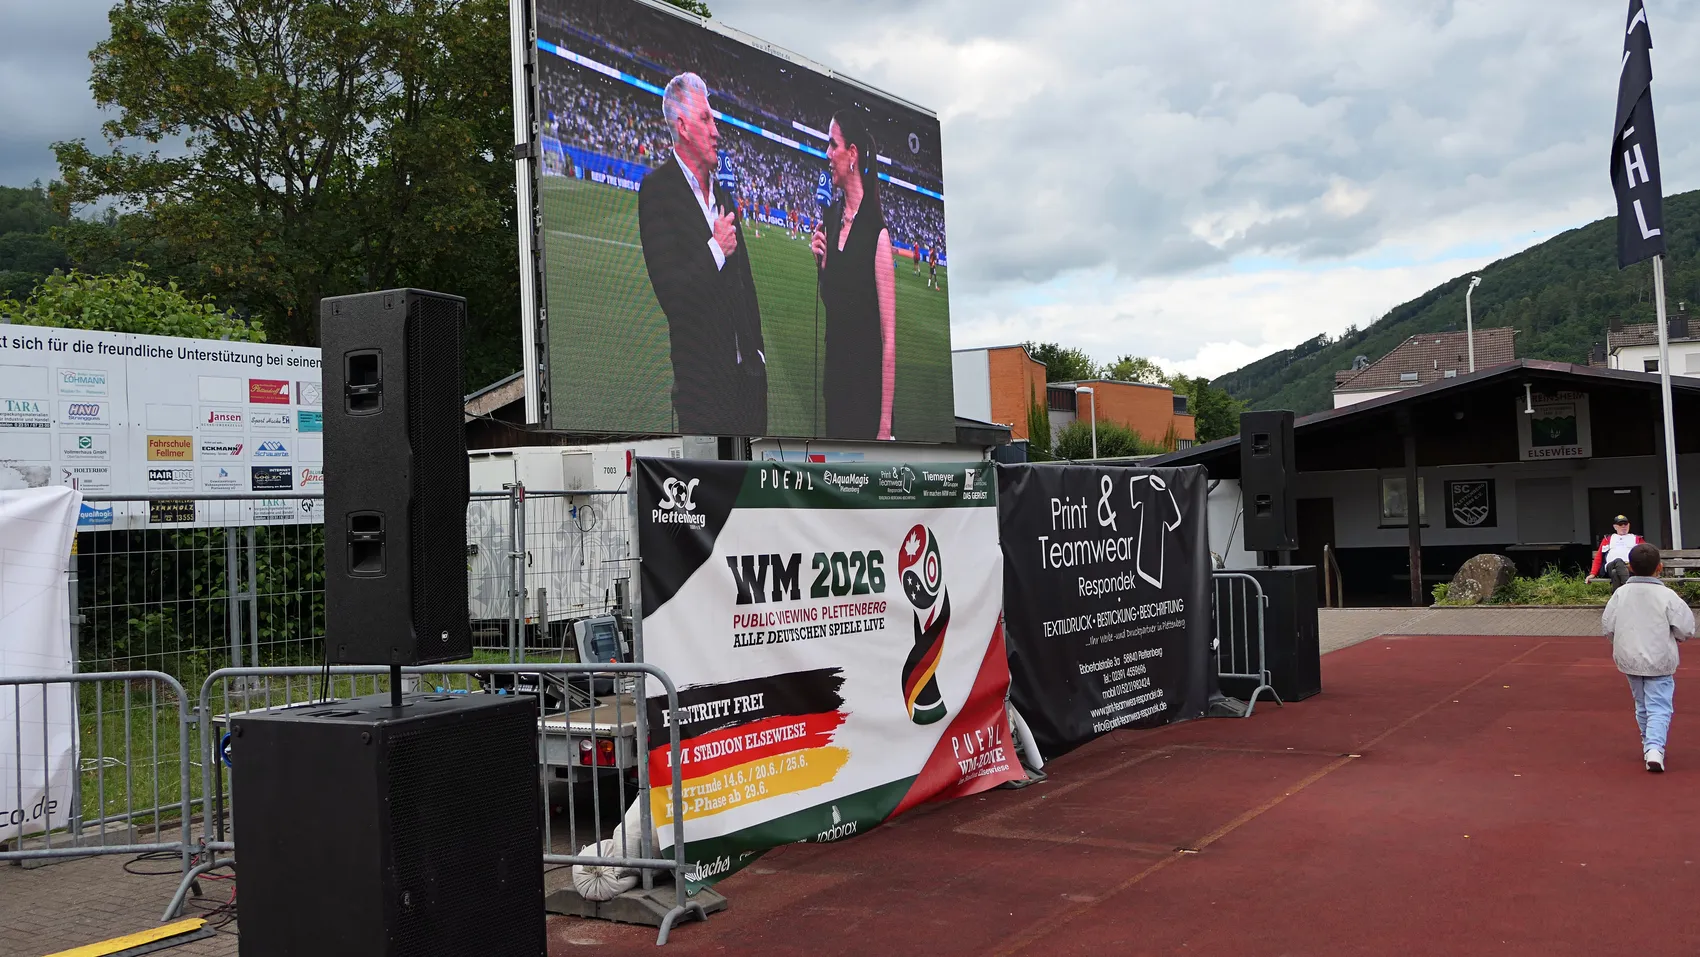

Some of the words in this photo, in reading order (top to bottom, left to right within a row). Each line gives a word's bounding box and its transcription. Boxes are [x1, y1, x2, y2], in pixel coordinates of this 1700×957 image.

[12, 336, 43, 351] sich
[48, 338, 68, 352] für
[73, 340, 94, 354] die
[98, 341, 173, 359] freundliche
[178, 347, 263, 367] Unterstützung
[267, 354, 284, 366] bei
[287, 356, 323, 369] seinen
[64, 375, 105, 385] LOHMANN
[5, 399, 40, 413] TARA
[68, 403, 100, 416] HAVO
[208, 411, 241, 423] Jansen
[149, 439, 191, 448] Fahrschule
[156, 449, 185, 457] Fellmer
[1528, 447, 1583, 458] ELSEWIESE
[149, 471, 172, 479] HAIR
[174, 471, 192, 479] LINE
[603, 466, 617, 475] 7003
[880, 470, 892, 479] Print
[892, 466, 899, 480] &
[922, 471, 955, 482] Tiemeyer
[760, 468, 814, 491] PUEHL
[832, 472, 869, 488] AquaMagis
[879, 478, 903, 487] Teamwear
[962, 491, 971, 500] DAS
[971, 489, 988, 500] GERÜST
[1453, 484, 1470, 494] SC
[1454, 483, 1485, 507] PLETTENBERG
[1051, 496, 1088, 531] Print
[1097, 474, 1118, 532] &
[80, 510, 112, 519] quaMagis
[652, 509, 706, 528] Plettenberg
[1038, 535, 1134, 569] Teamwear
[725, 553, 802, 606] WM
[810, 549, 886, 599] 2026
[1078, 570, 1136, 599] Respondek
[733, 611, 776, 629] PUBLIC
[776, 607, 818, 626] VIEWING
[821, 601, 887, 620] PLETTENBERG
[1043, 614, 1093, 638] TEXTILDRUCK
[1096, 606, 1137, 628] BESTICKUNG
[1139, 598, 1184, 620] BESCHRIFTUNG
[733, 632, 765, 649] ALLE
[766, 624, 827, 644] DEUTSCHEN
[829, 619, 862, 637] SPIELE
[863, 617, 885, 631] LIVE
[1123, 652, 1138, 665] 58840
[1137, 647, 1163, 660] Plettenberg
[1112, 669, 1125, 682] 02391
[1102, 688, 1116, 700] mobil
[733, 692, 765, 715] FREI
[693, 736, 743, 763] STADION
[745, 722, 807, 751] ELSEWIESE
[951, 724, 1002, 759] PUEHL
[958, 747, 1006, 775] WM-ZONE
[723, 771, 748, 787] 14.6.
[755, 764, 778, 780] 20.6.
[786, 754, 809, 771] 25.6.
[728, 789, 742, 804] ab
[744, 781, 769, 799] 29.6.
